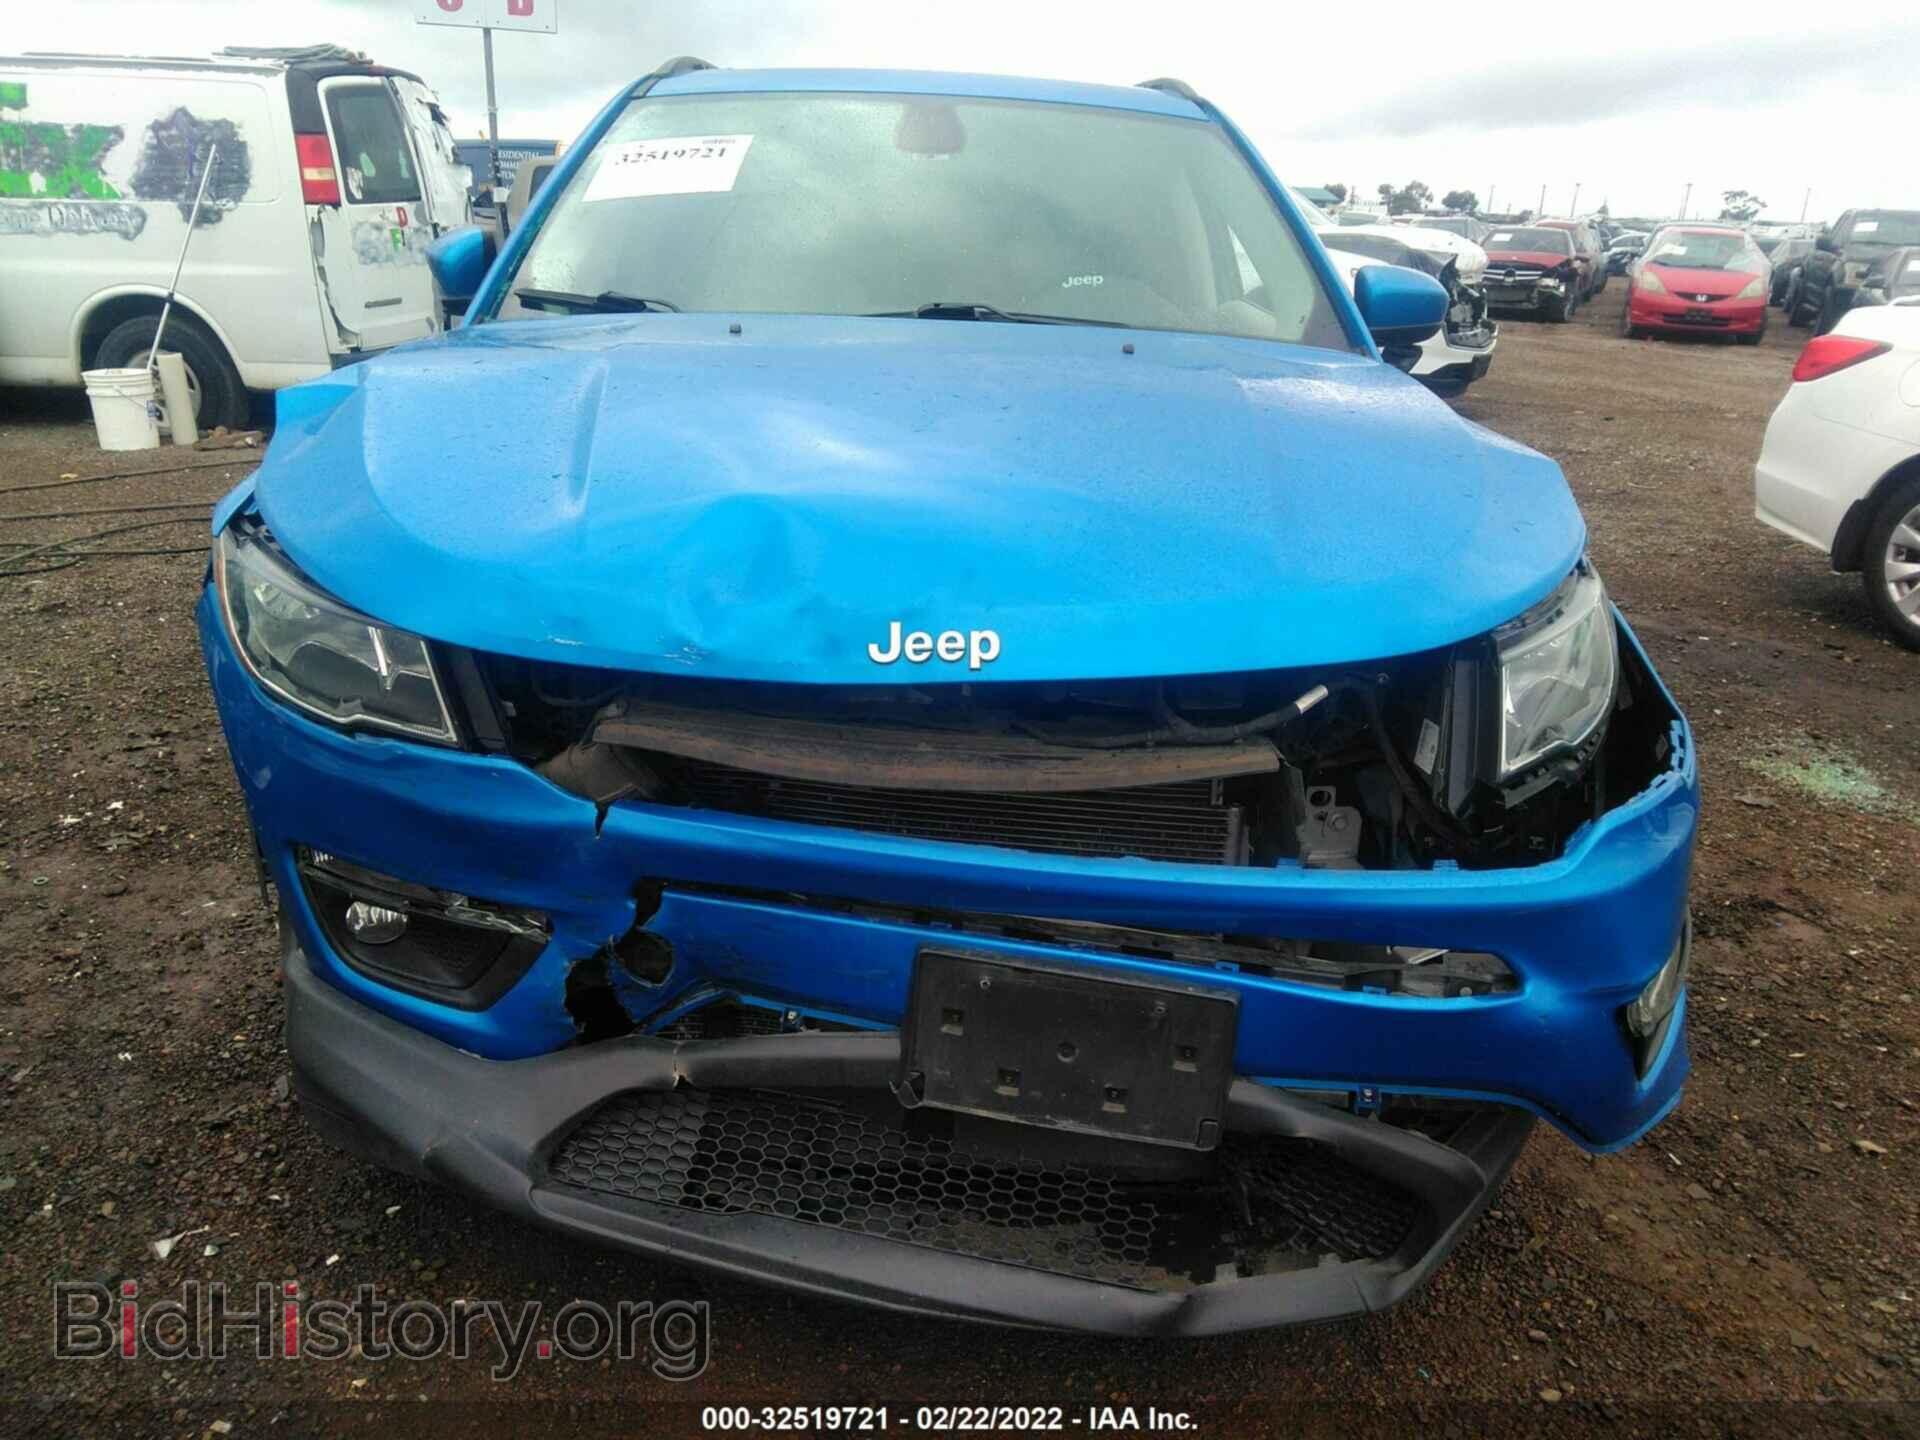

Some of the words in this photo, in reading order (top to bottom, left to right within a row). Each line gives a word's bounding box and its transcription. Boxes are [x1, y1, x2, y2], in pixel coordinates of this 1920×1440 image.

[614, 147, 727, 167] 32519721
[1062, 275, 1104, 288] Jeep
[867, 621, 1001, 669] Jeep
